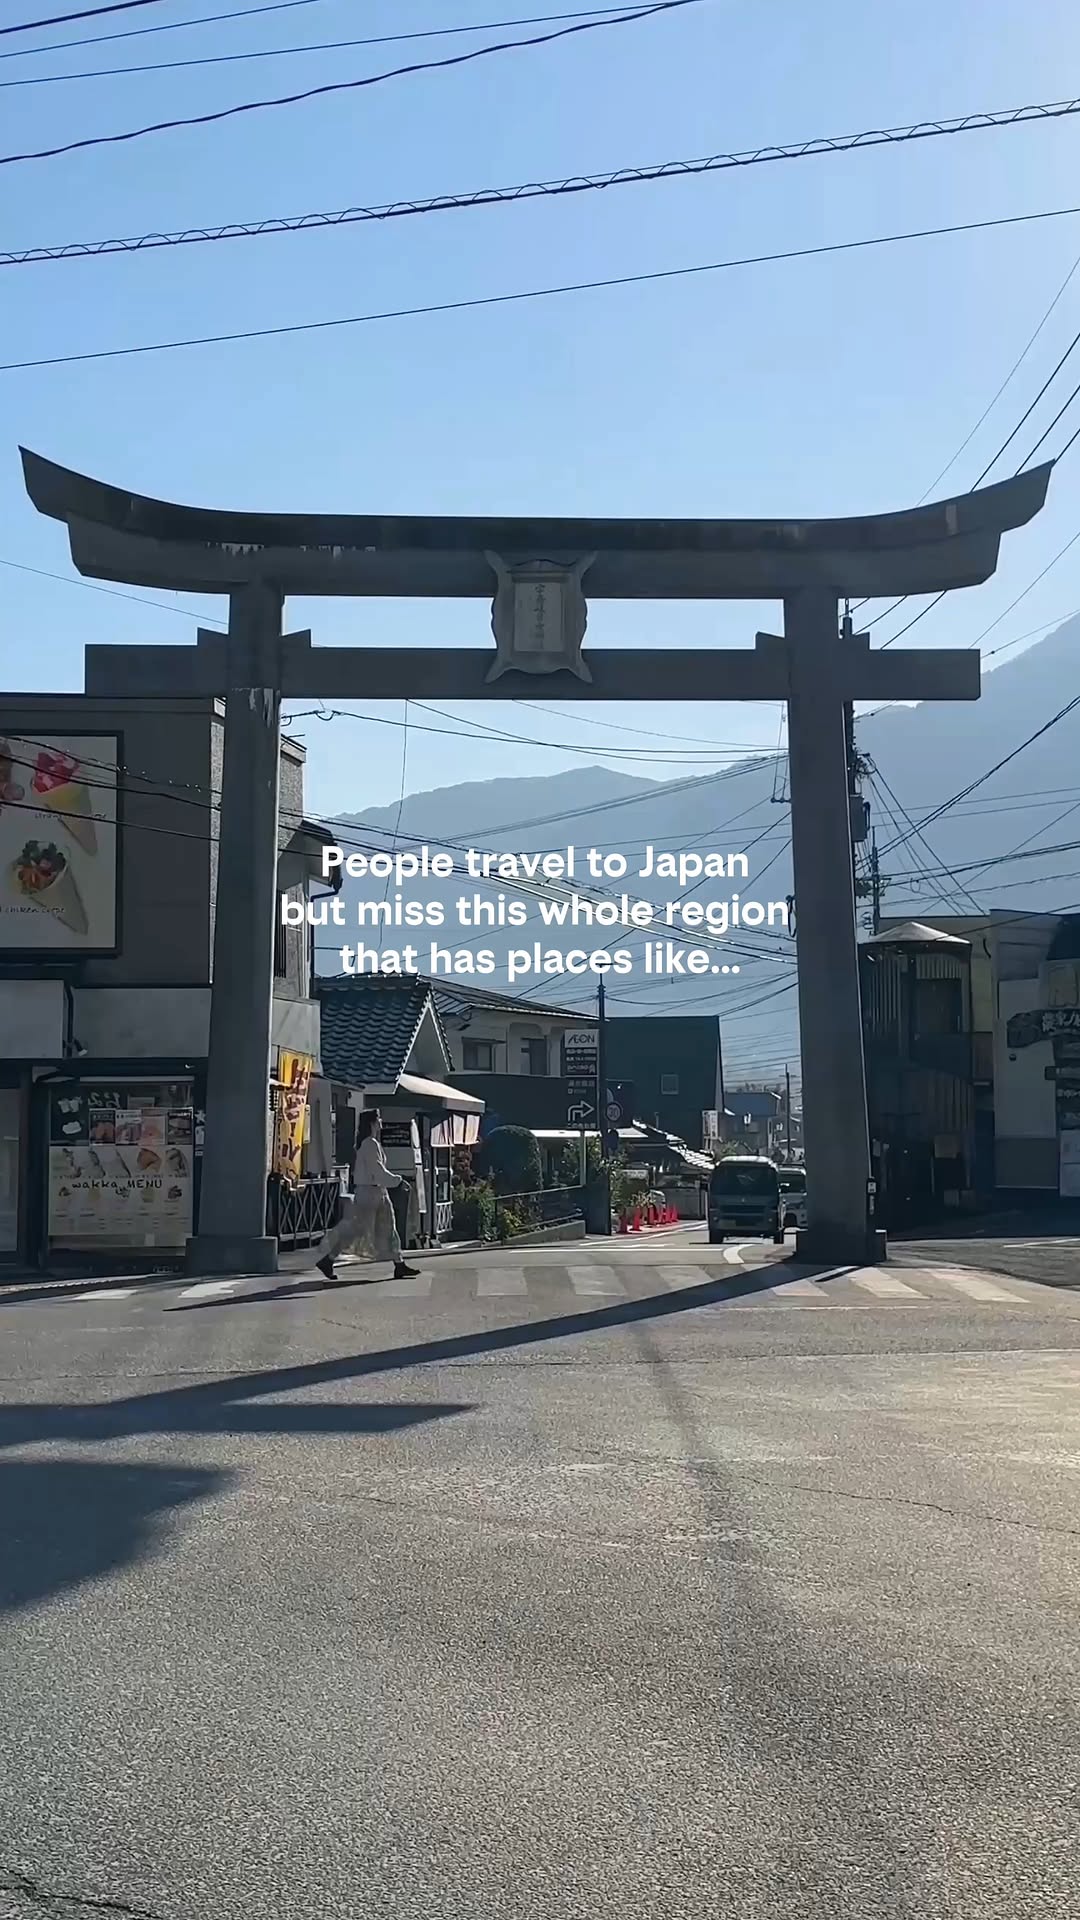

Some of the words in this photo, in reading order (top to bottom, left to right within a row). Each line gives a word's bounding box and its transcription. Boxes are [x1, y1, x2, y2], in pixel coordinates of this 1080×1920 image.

[567, 1034, 595, 1044] AEON
[71, 1179, 118, 1189] wakka
[127, 1178, 163, 1189] MENU
